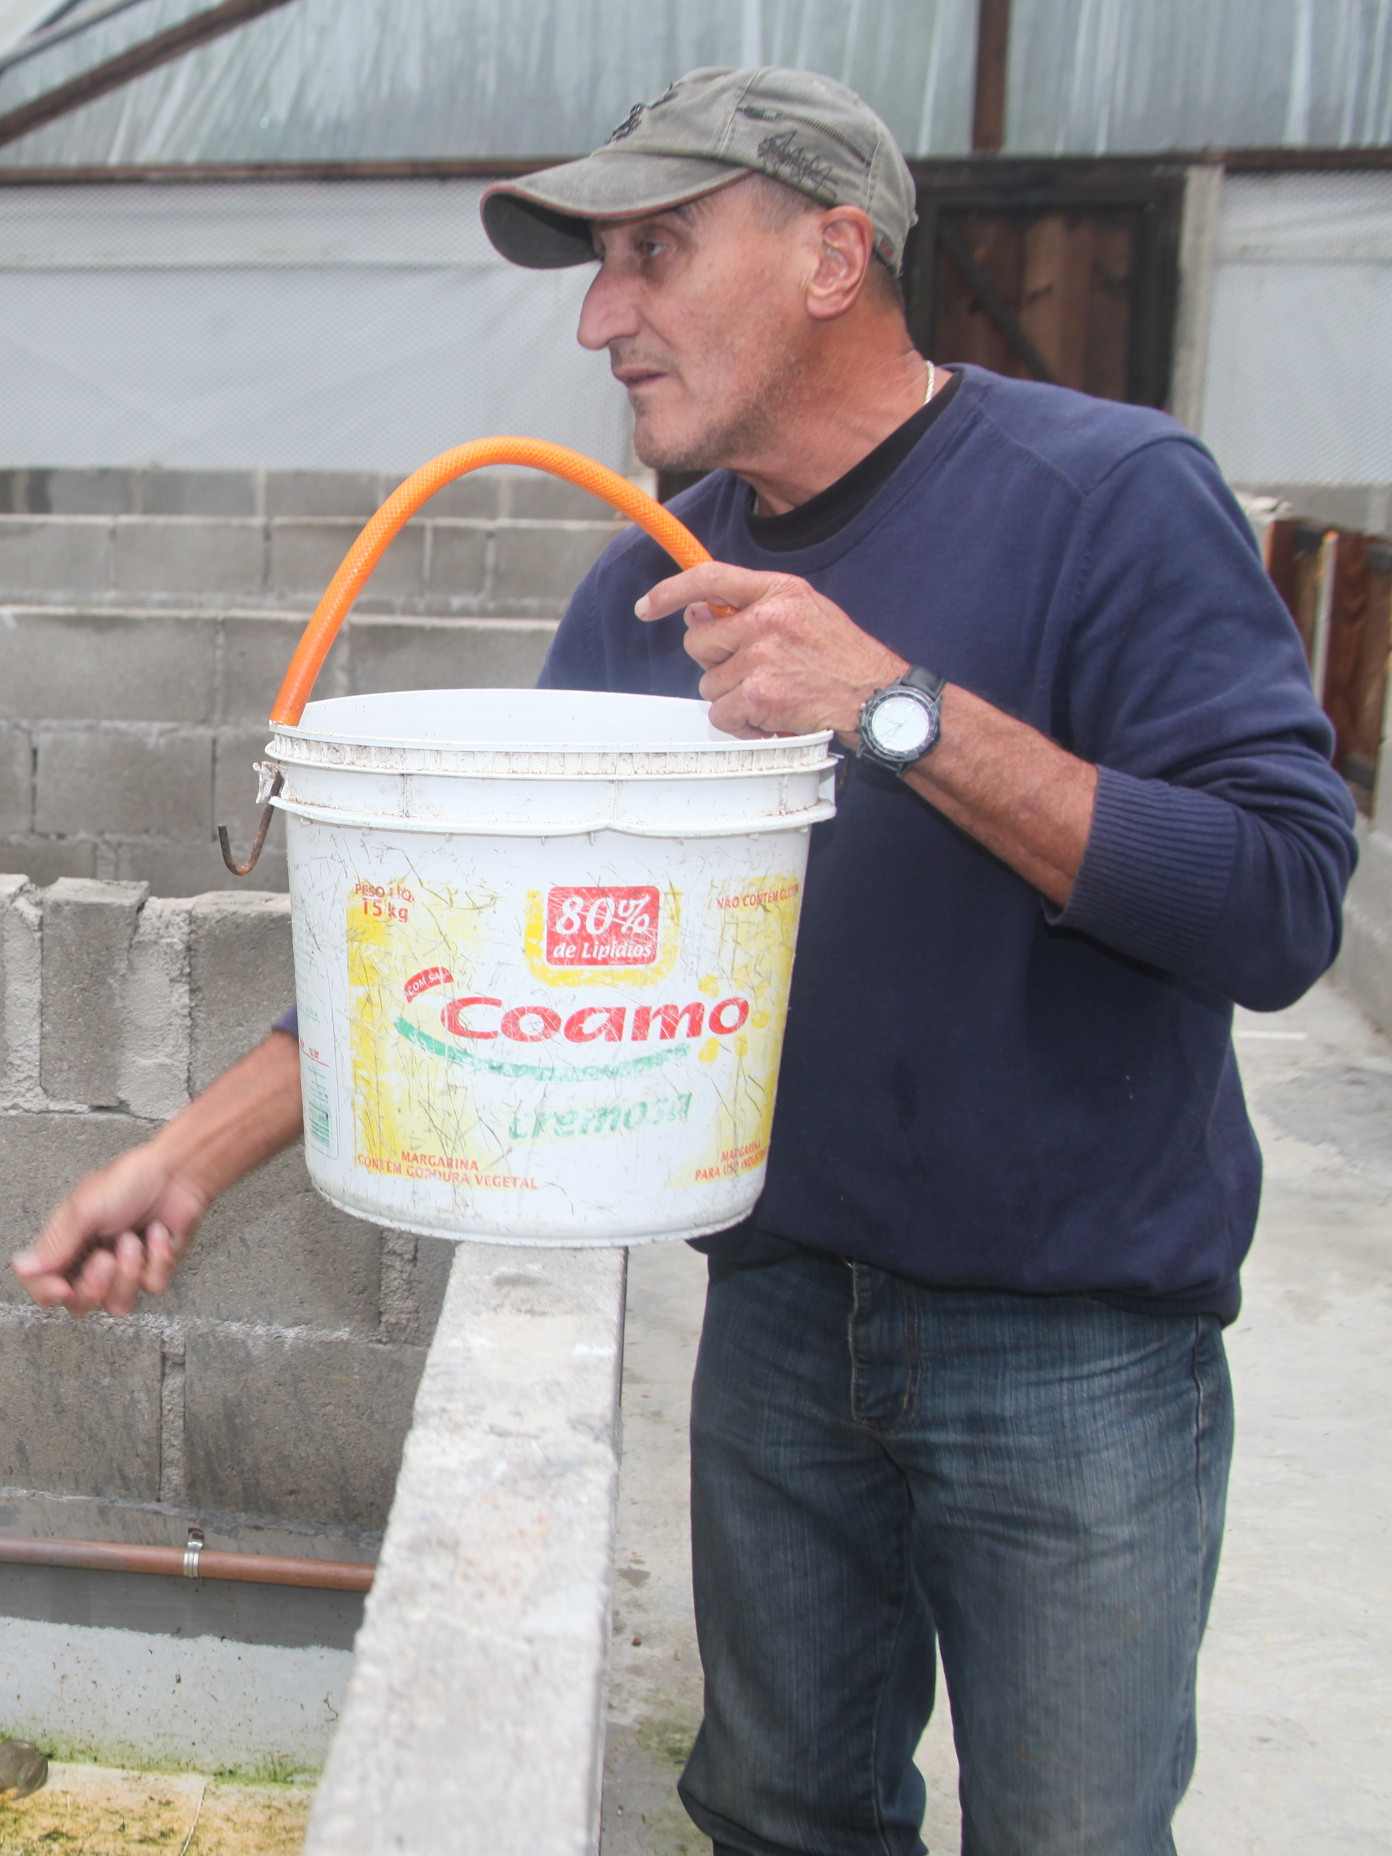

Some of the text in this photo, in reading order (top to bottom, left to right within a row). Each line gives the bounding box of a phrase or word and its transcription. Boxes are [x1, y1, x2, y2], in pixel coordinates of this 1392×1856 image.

[354, 883, 386, 898] PESO
[362, 897, 409, 923] 15 kg
[555, 893, 652, 935] 80%
[553, 942, 577, 959] de
[407, 974, 427, 996] COM
[440, 996, 749, 1043] Coamo
[400, 1150, 479, 1171] MARGARINA
[406, 1165, 471, 1186] GORDURA
[474, 1174, 539, 1190] VEGETAL
[694, 1166, 720, 1181] PARA
